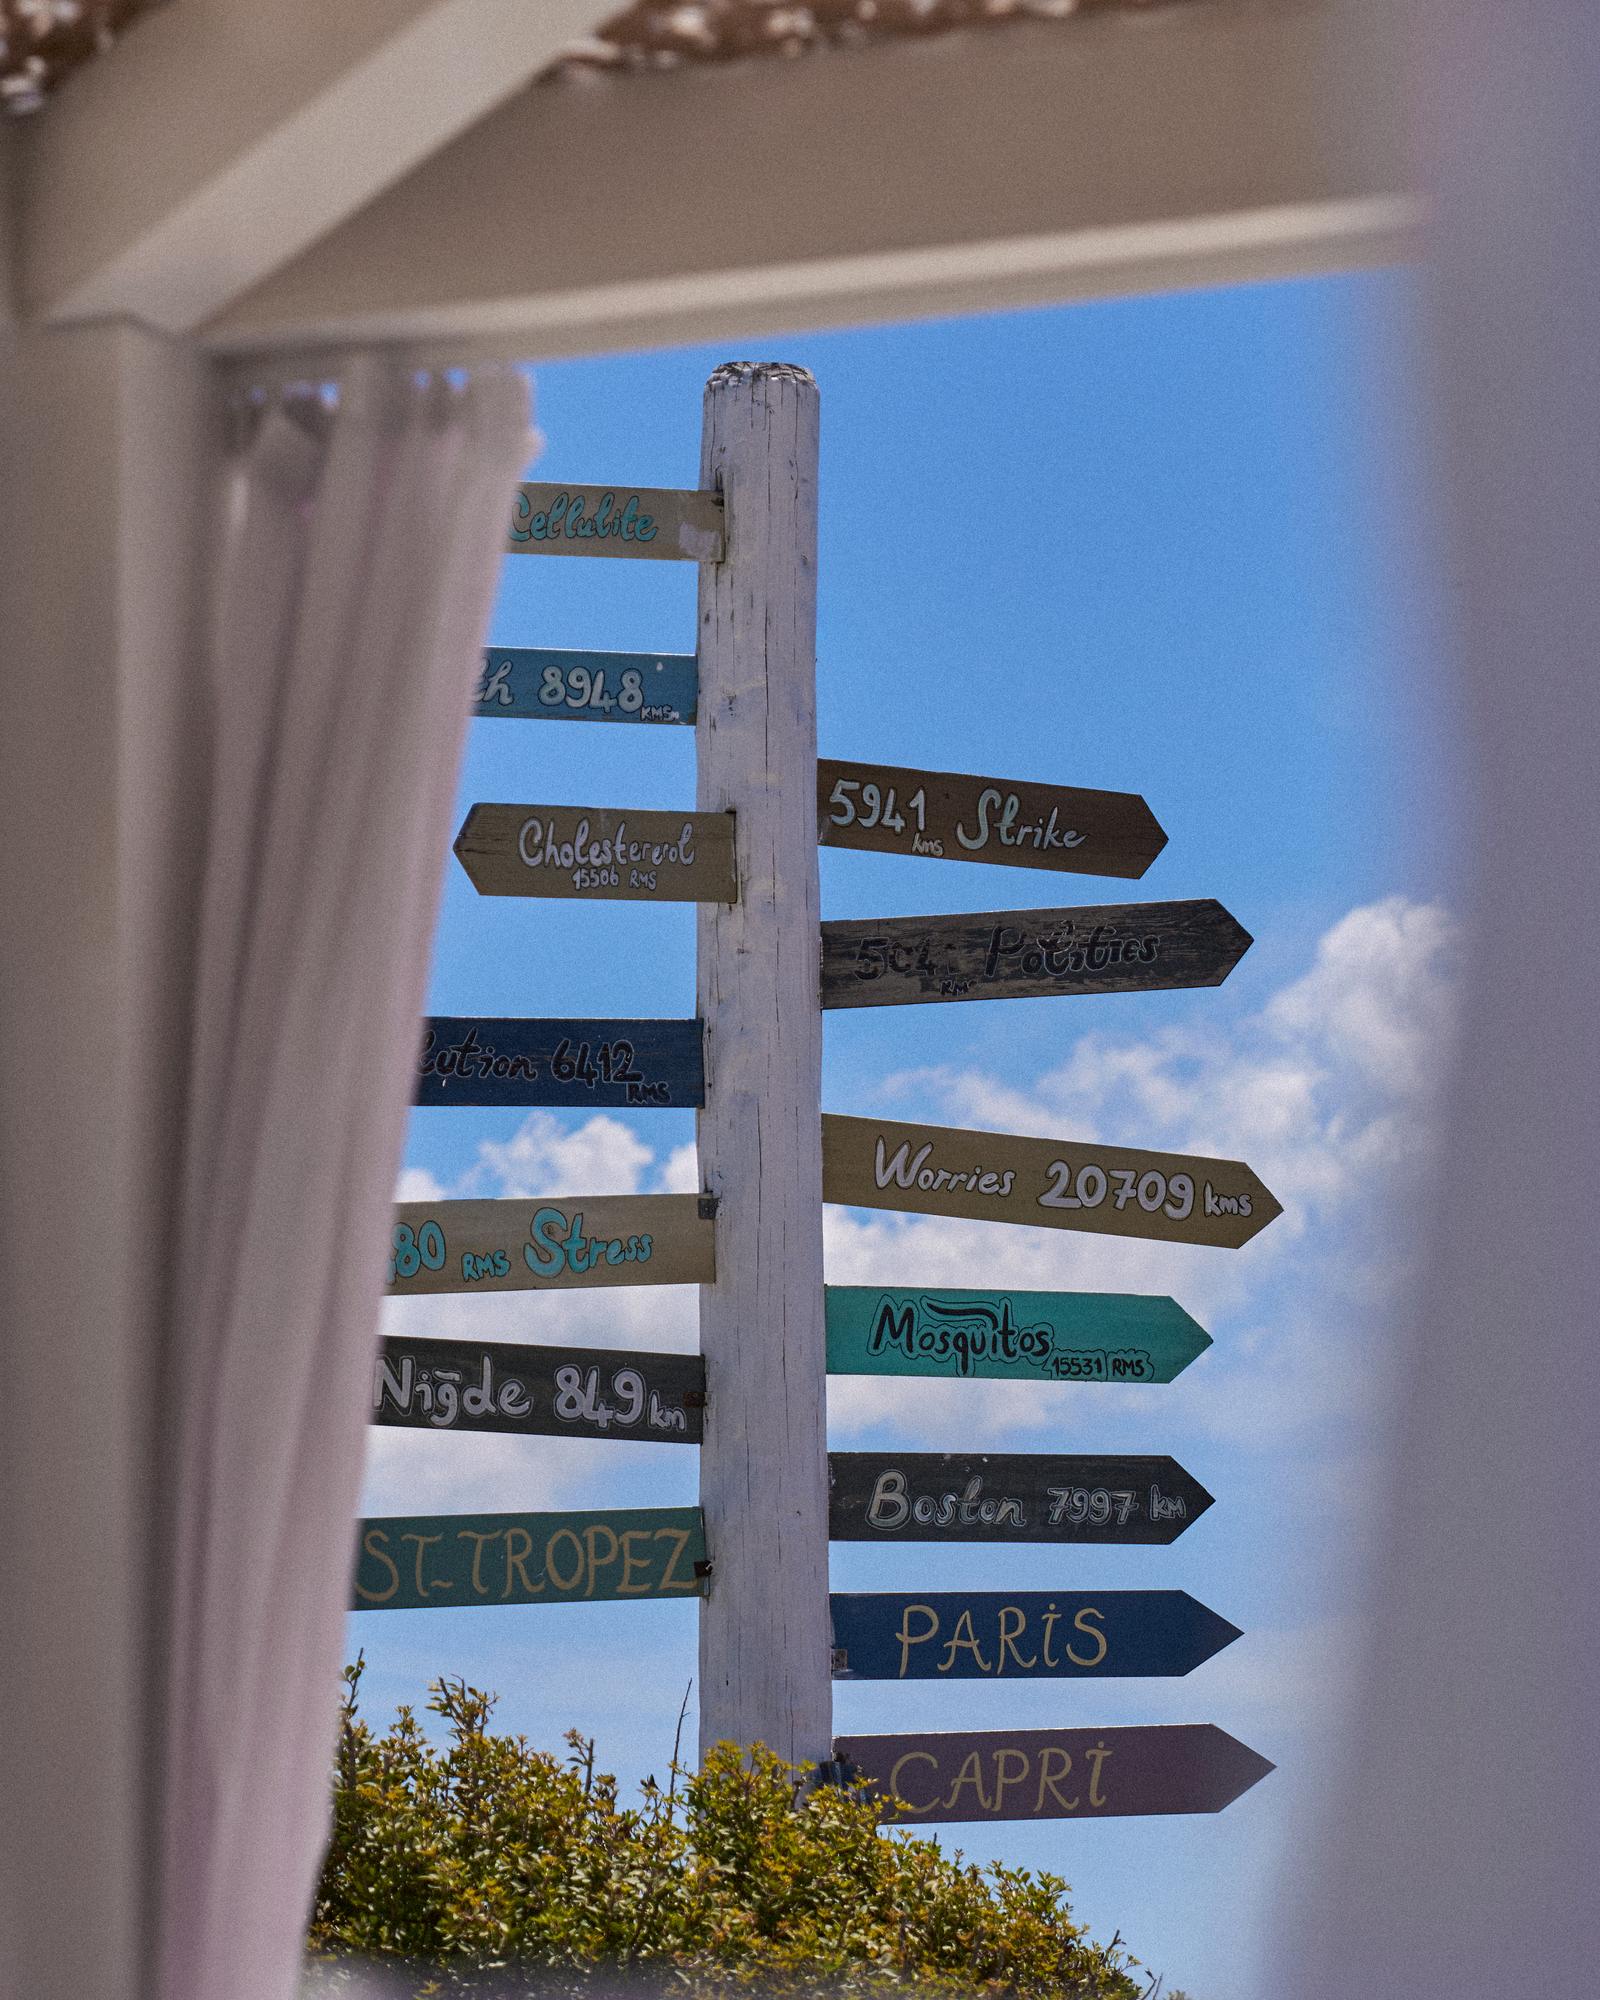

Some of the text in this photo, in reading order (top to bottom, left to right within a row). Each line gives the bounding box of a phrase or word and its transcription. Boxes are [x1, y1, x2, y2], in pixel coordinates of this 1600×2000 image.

[510, 490, 658, 541] Cellulite
[538, 665, 643, 713] 8948
[829, 778, 928, 835] 5941
[956, 787, 1090, 850] Strike
[571, 864, 620, 890] 15506
[551, 1039, 644, 1088] 6412
[874, 1135, 1254, 1221] Worries 20709 kms
[386, 1206, 654, 1285] 80 RMS Stress
[870, 1295, 1147, 1378] Mosquitos 15531 RMS
[554, 1364, 647, 1429] 849
[865, 1469, 1027, 1531] Boston
[1047, 1487, 1140, 1526] 7997
